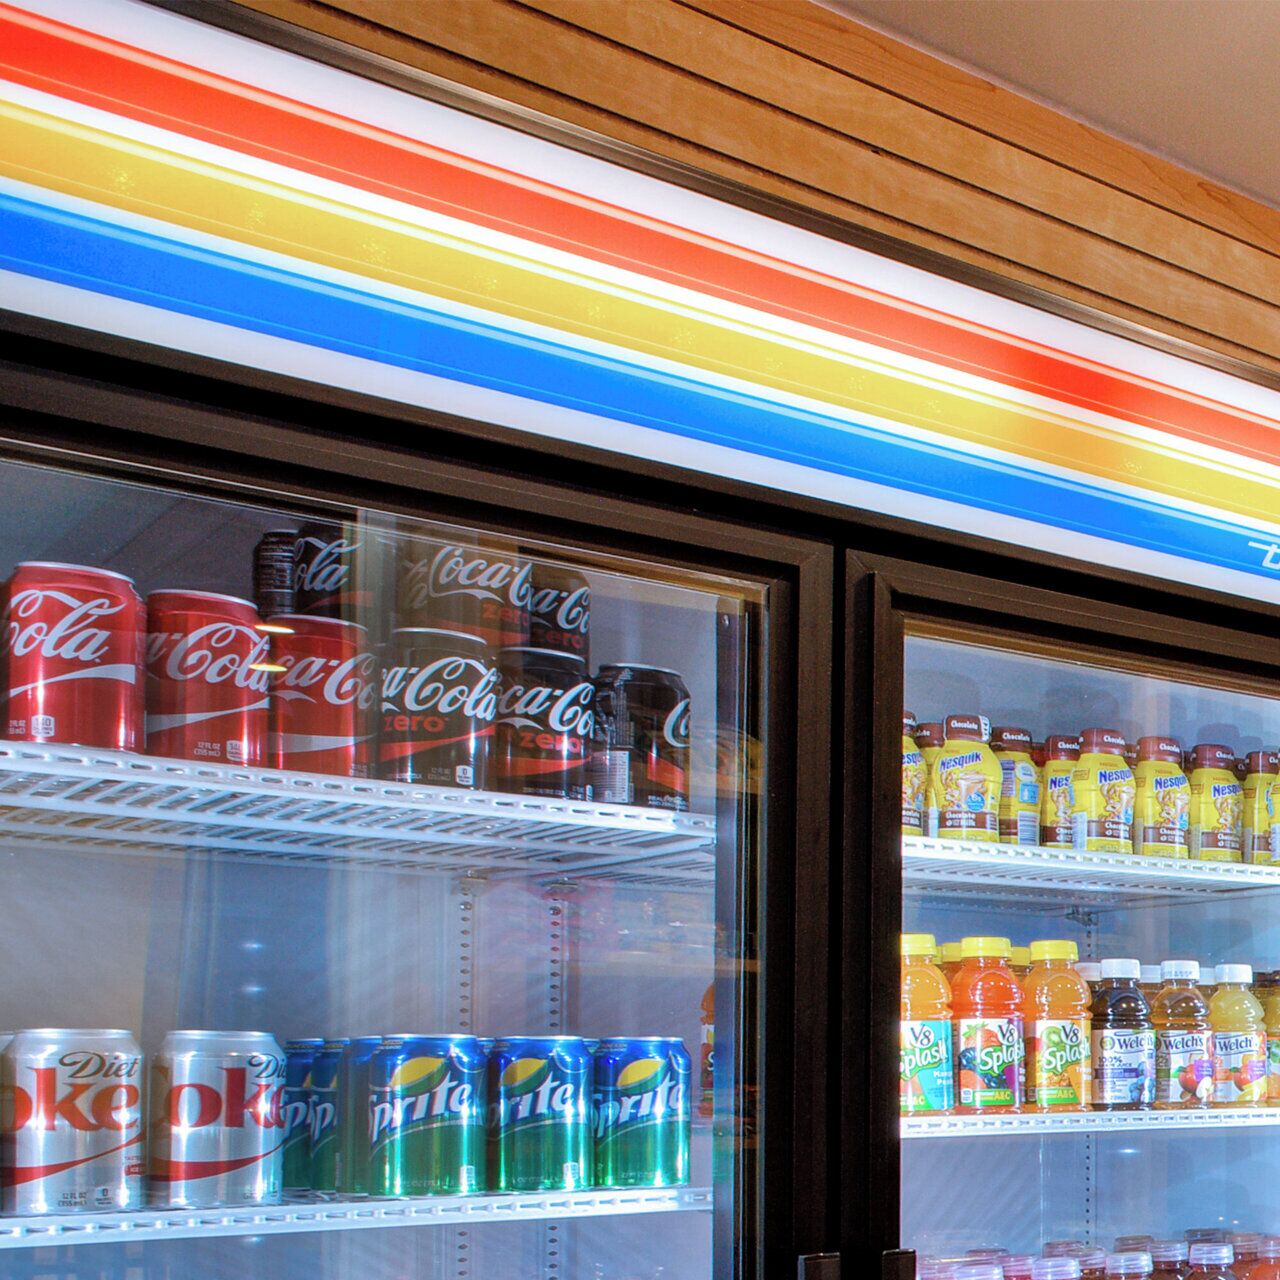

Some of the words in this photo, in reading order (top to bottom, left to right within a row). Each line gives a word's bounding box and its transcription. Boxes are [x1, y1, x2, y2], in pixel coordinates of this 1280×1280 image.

[384, 715, 447, 732] zero
[939, 751, 982, 772] Nesquik
[910, 1024, 932, 1047] V8
[998, 1023, 1017, 1045] V8
[1061, 1024, 1080, 1045] V8
[1163, 1036, 1204, 1050] Welch's
[59, 1051, 139, 1079] Diet
